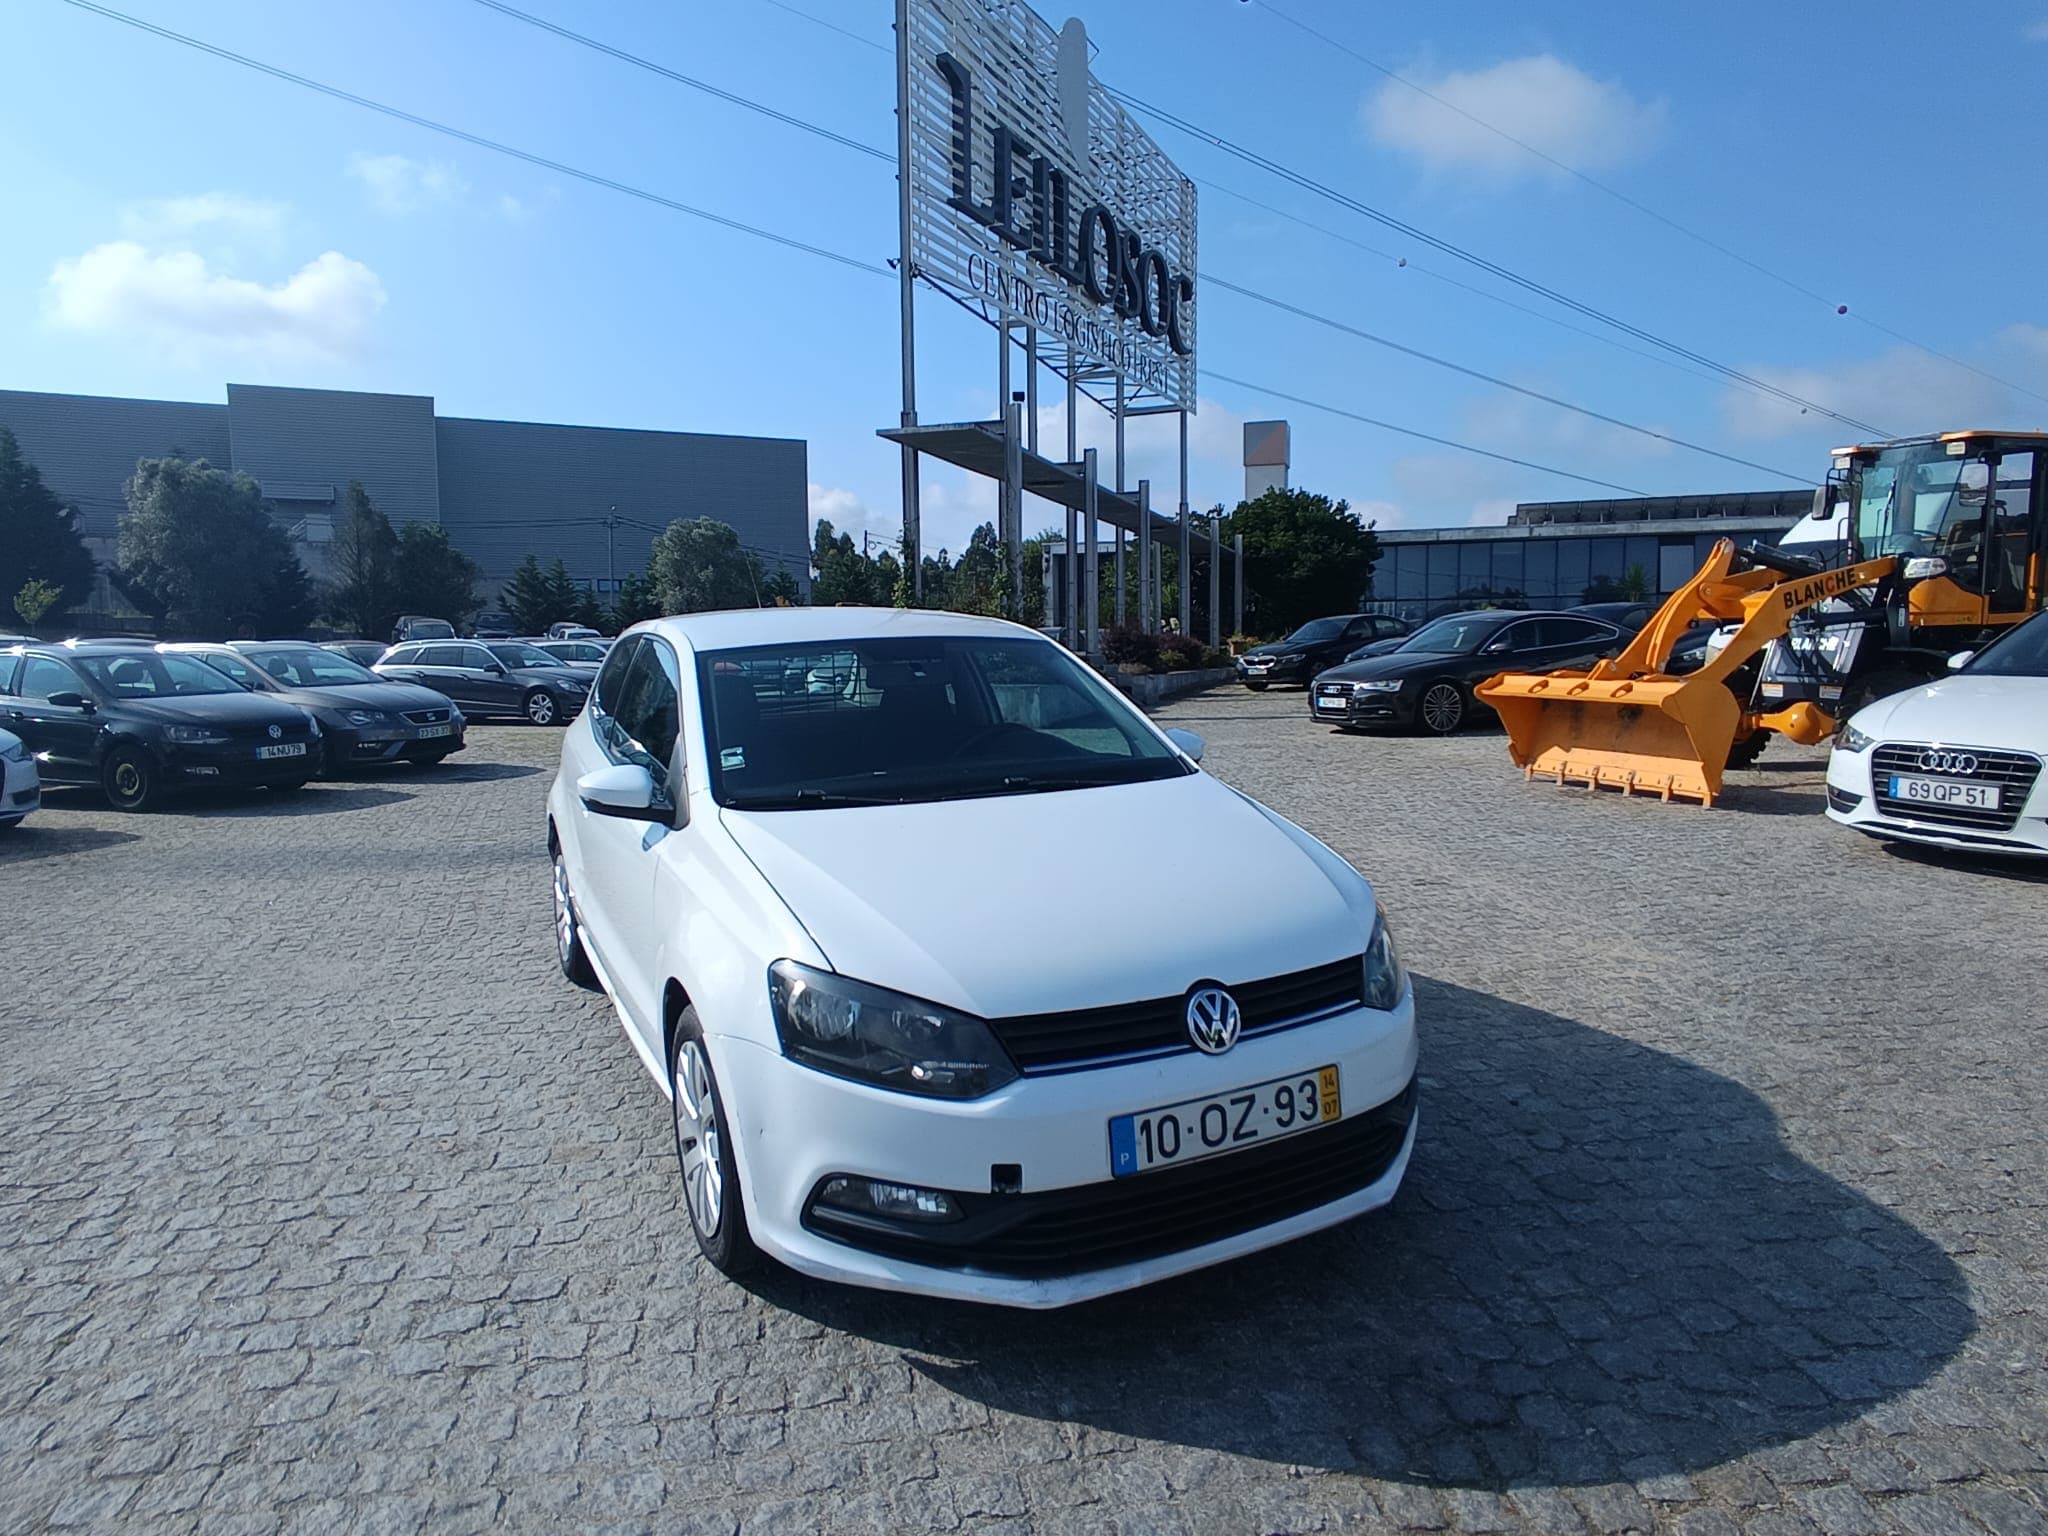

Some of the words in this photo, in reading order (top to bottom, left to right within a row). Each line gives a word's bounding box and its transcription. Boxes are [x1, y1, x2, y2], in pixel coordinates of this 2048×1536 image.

[935, 51, 1193, 355] LEILOSOC
[968, 252, 1048, 327] CENTRO
[1783, 567, 1857, 610] BLANCHE
[1323, 1098, 1338, 1115] 07
[1120, 1151, 1130, 1166] P
